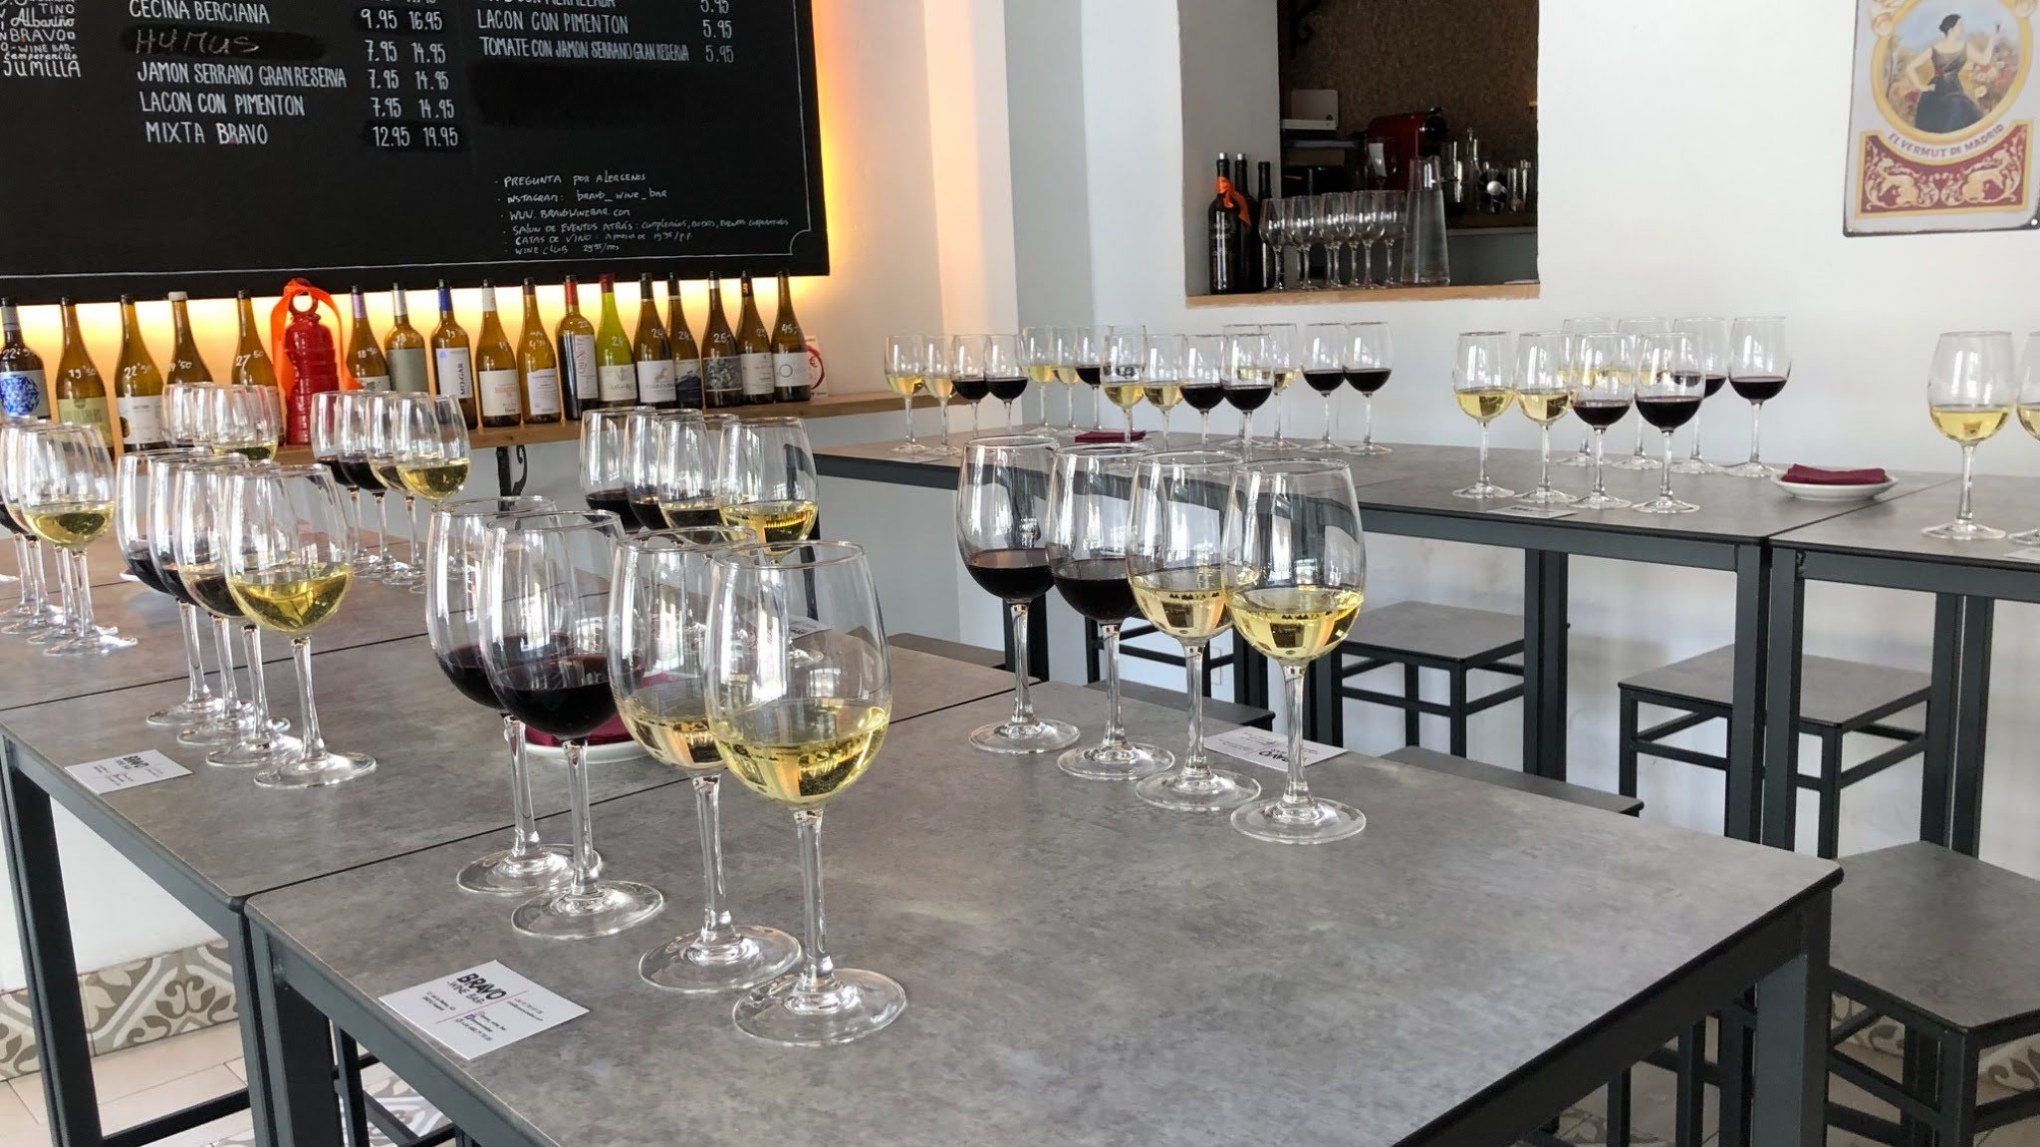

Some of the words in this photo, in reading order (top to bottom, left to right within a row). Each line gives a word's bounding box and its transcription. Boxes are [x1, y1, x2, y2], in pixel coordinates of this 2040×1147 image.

[129, 0, 190, 20] CECINA
[195, 1, 271, 25] BERCIANA
[361, 9, 398, 29] 9.95
[408, 11, 443, 31] 16.95
[477, 9, 523, 30] LACON
[531, 11, 559, 31] CON
[563, 13, 629, 34] PIMENTON
[702, 19, 733, 39] 5.95
[364, 39, 398, 62] 7.95
[411, 42, 447, 63] 14.95
[479, 36, 530, 56] TOMATE
[531, 39, 553, 57] CON
[555, 40, 589, 58] JAMON
[705, 45, 734, 63] 5.95
[137, 61, 190, 84] JAMON
[194, 63, 254, 86] SERRANO
[259, 66, 294, 87] GRAN
[294, 67, 348, 88] RESERVA
[367, 69, 399, 89] 7.95
[415, 70, 449, 90] 14.95
[139, 91, 193, 114] LACON
[198, 92, 227, 115] CON
[234, 94, 305, 116] PIMENTON
[370, 97, 402, 118] 7.95
[418, 99, 455, 119] 14.95
[146, 121, 205, 144] MIXTA
[216, 122, 268, 145] BRAVO
[373, 126, 411, 147] 12.95
[423, 127, 459, 148] 19.95
[1900, 140, 1947, 158] VERMUT
[457, 972, 507, 1001] BRAVO
